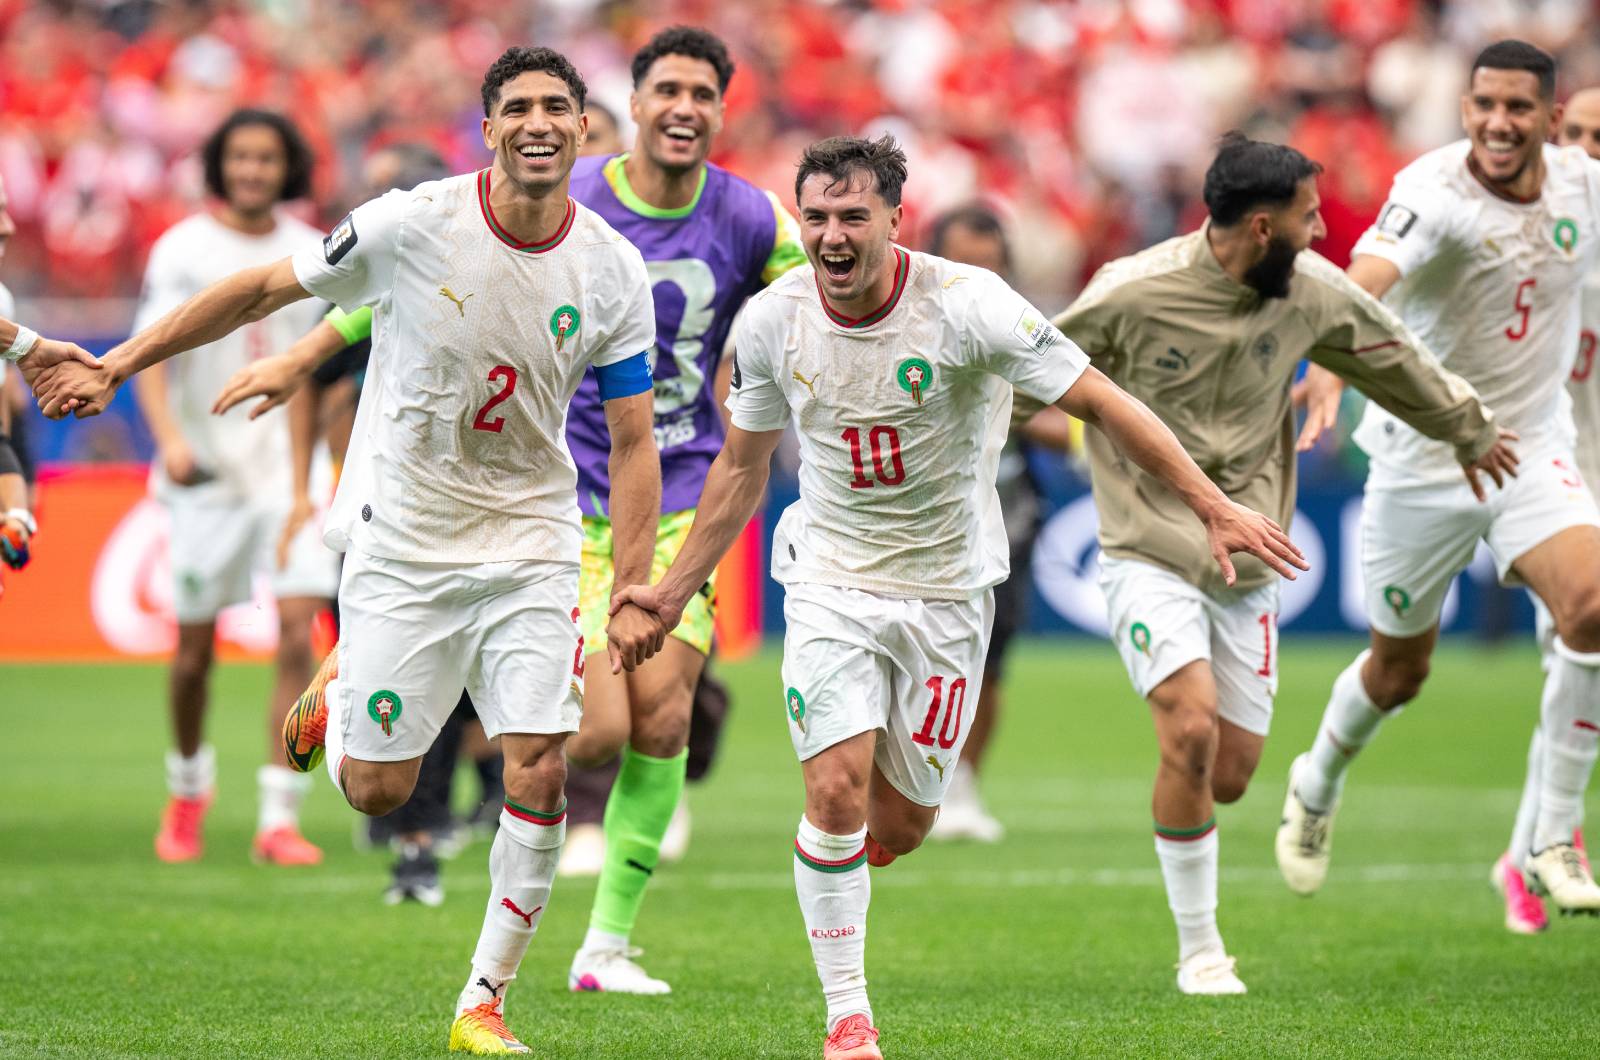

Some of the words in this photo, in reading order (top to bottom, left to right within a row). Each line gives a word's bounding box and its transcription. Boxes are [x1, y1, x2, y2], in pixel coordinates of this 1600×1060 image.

[1505, 278, 1536, 340] 5
[473, 364, 517, 433] 2
[841, 425, 906, 488] 10
[911, 676, 967, 749] 10
